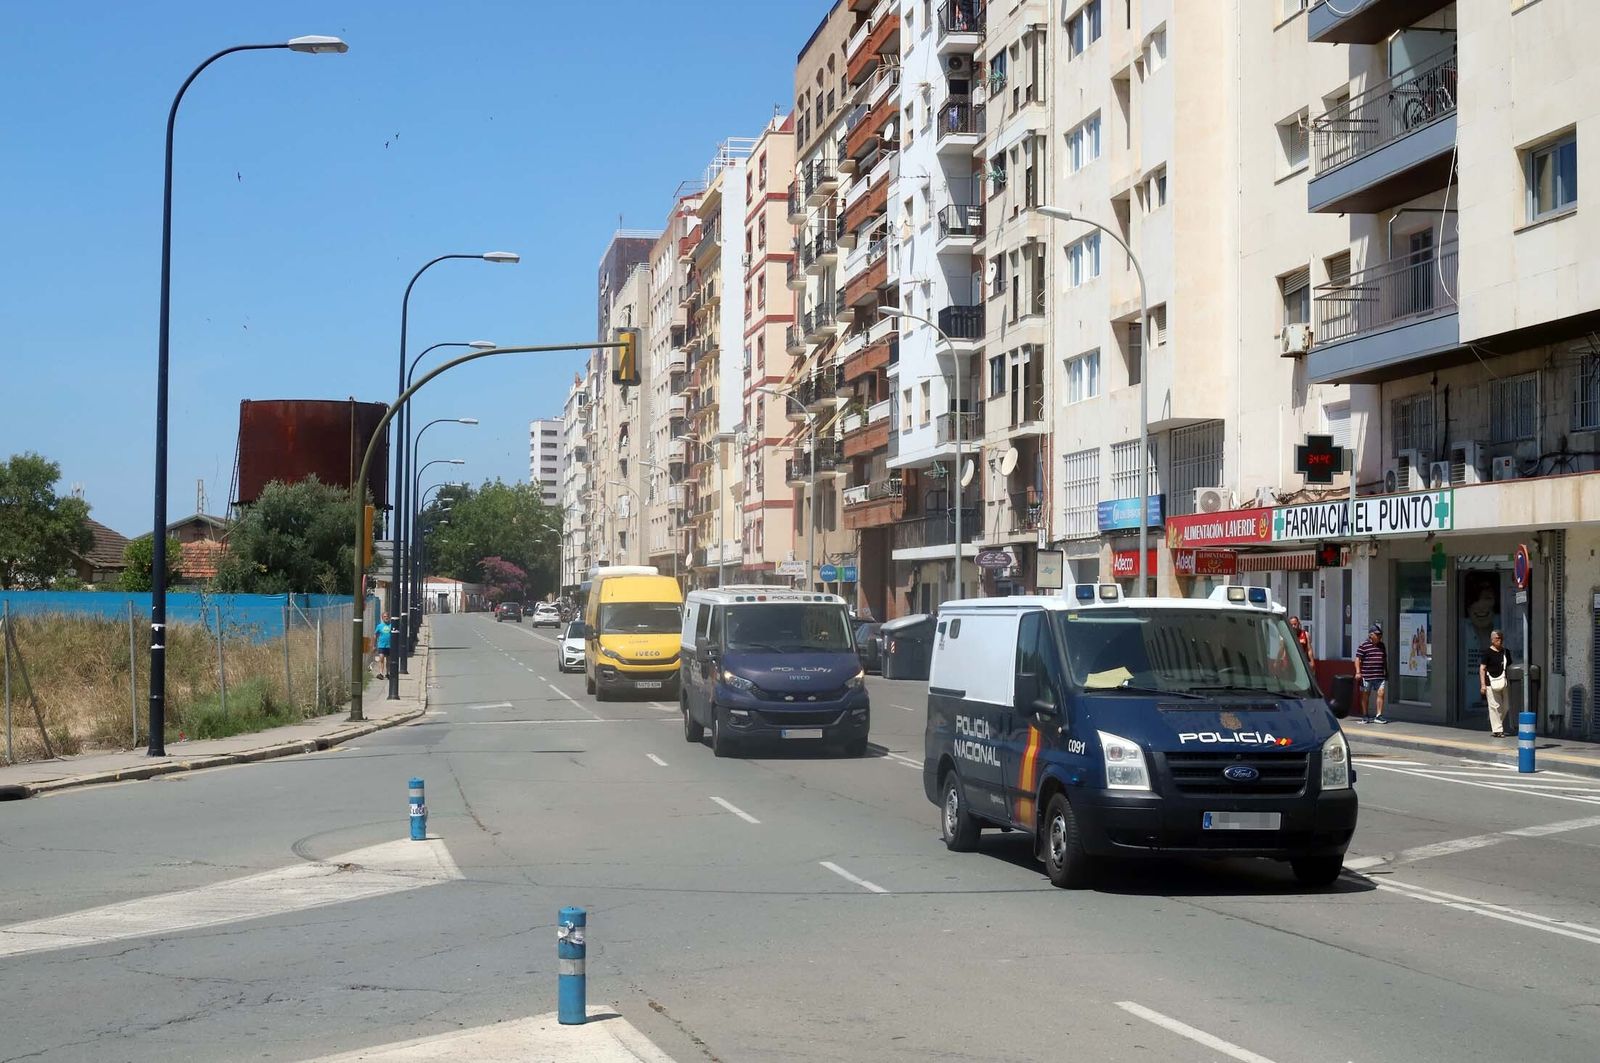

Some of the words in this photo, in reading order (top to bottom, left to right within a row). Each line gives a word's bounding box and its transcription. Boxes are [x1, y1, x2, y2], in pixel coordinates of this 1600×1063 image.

[1285, 502, 1350, 538] FARMACIA
[1355, 502, 1373, 532] EL
[1379, 495, 1433, 531] PUNTO
[1183, 520, 1224, 540] ALIMENTACIÓN
[1225, 518, 1257, 538] LAVERDE
[1114, 553, 1134, 571] Adecco
[1178, 731, 1277, 744] POLICÍA
[954, 739, 1001, 767] NACIONAL
[1232, 769, 1252, 778] Ford
